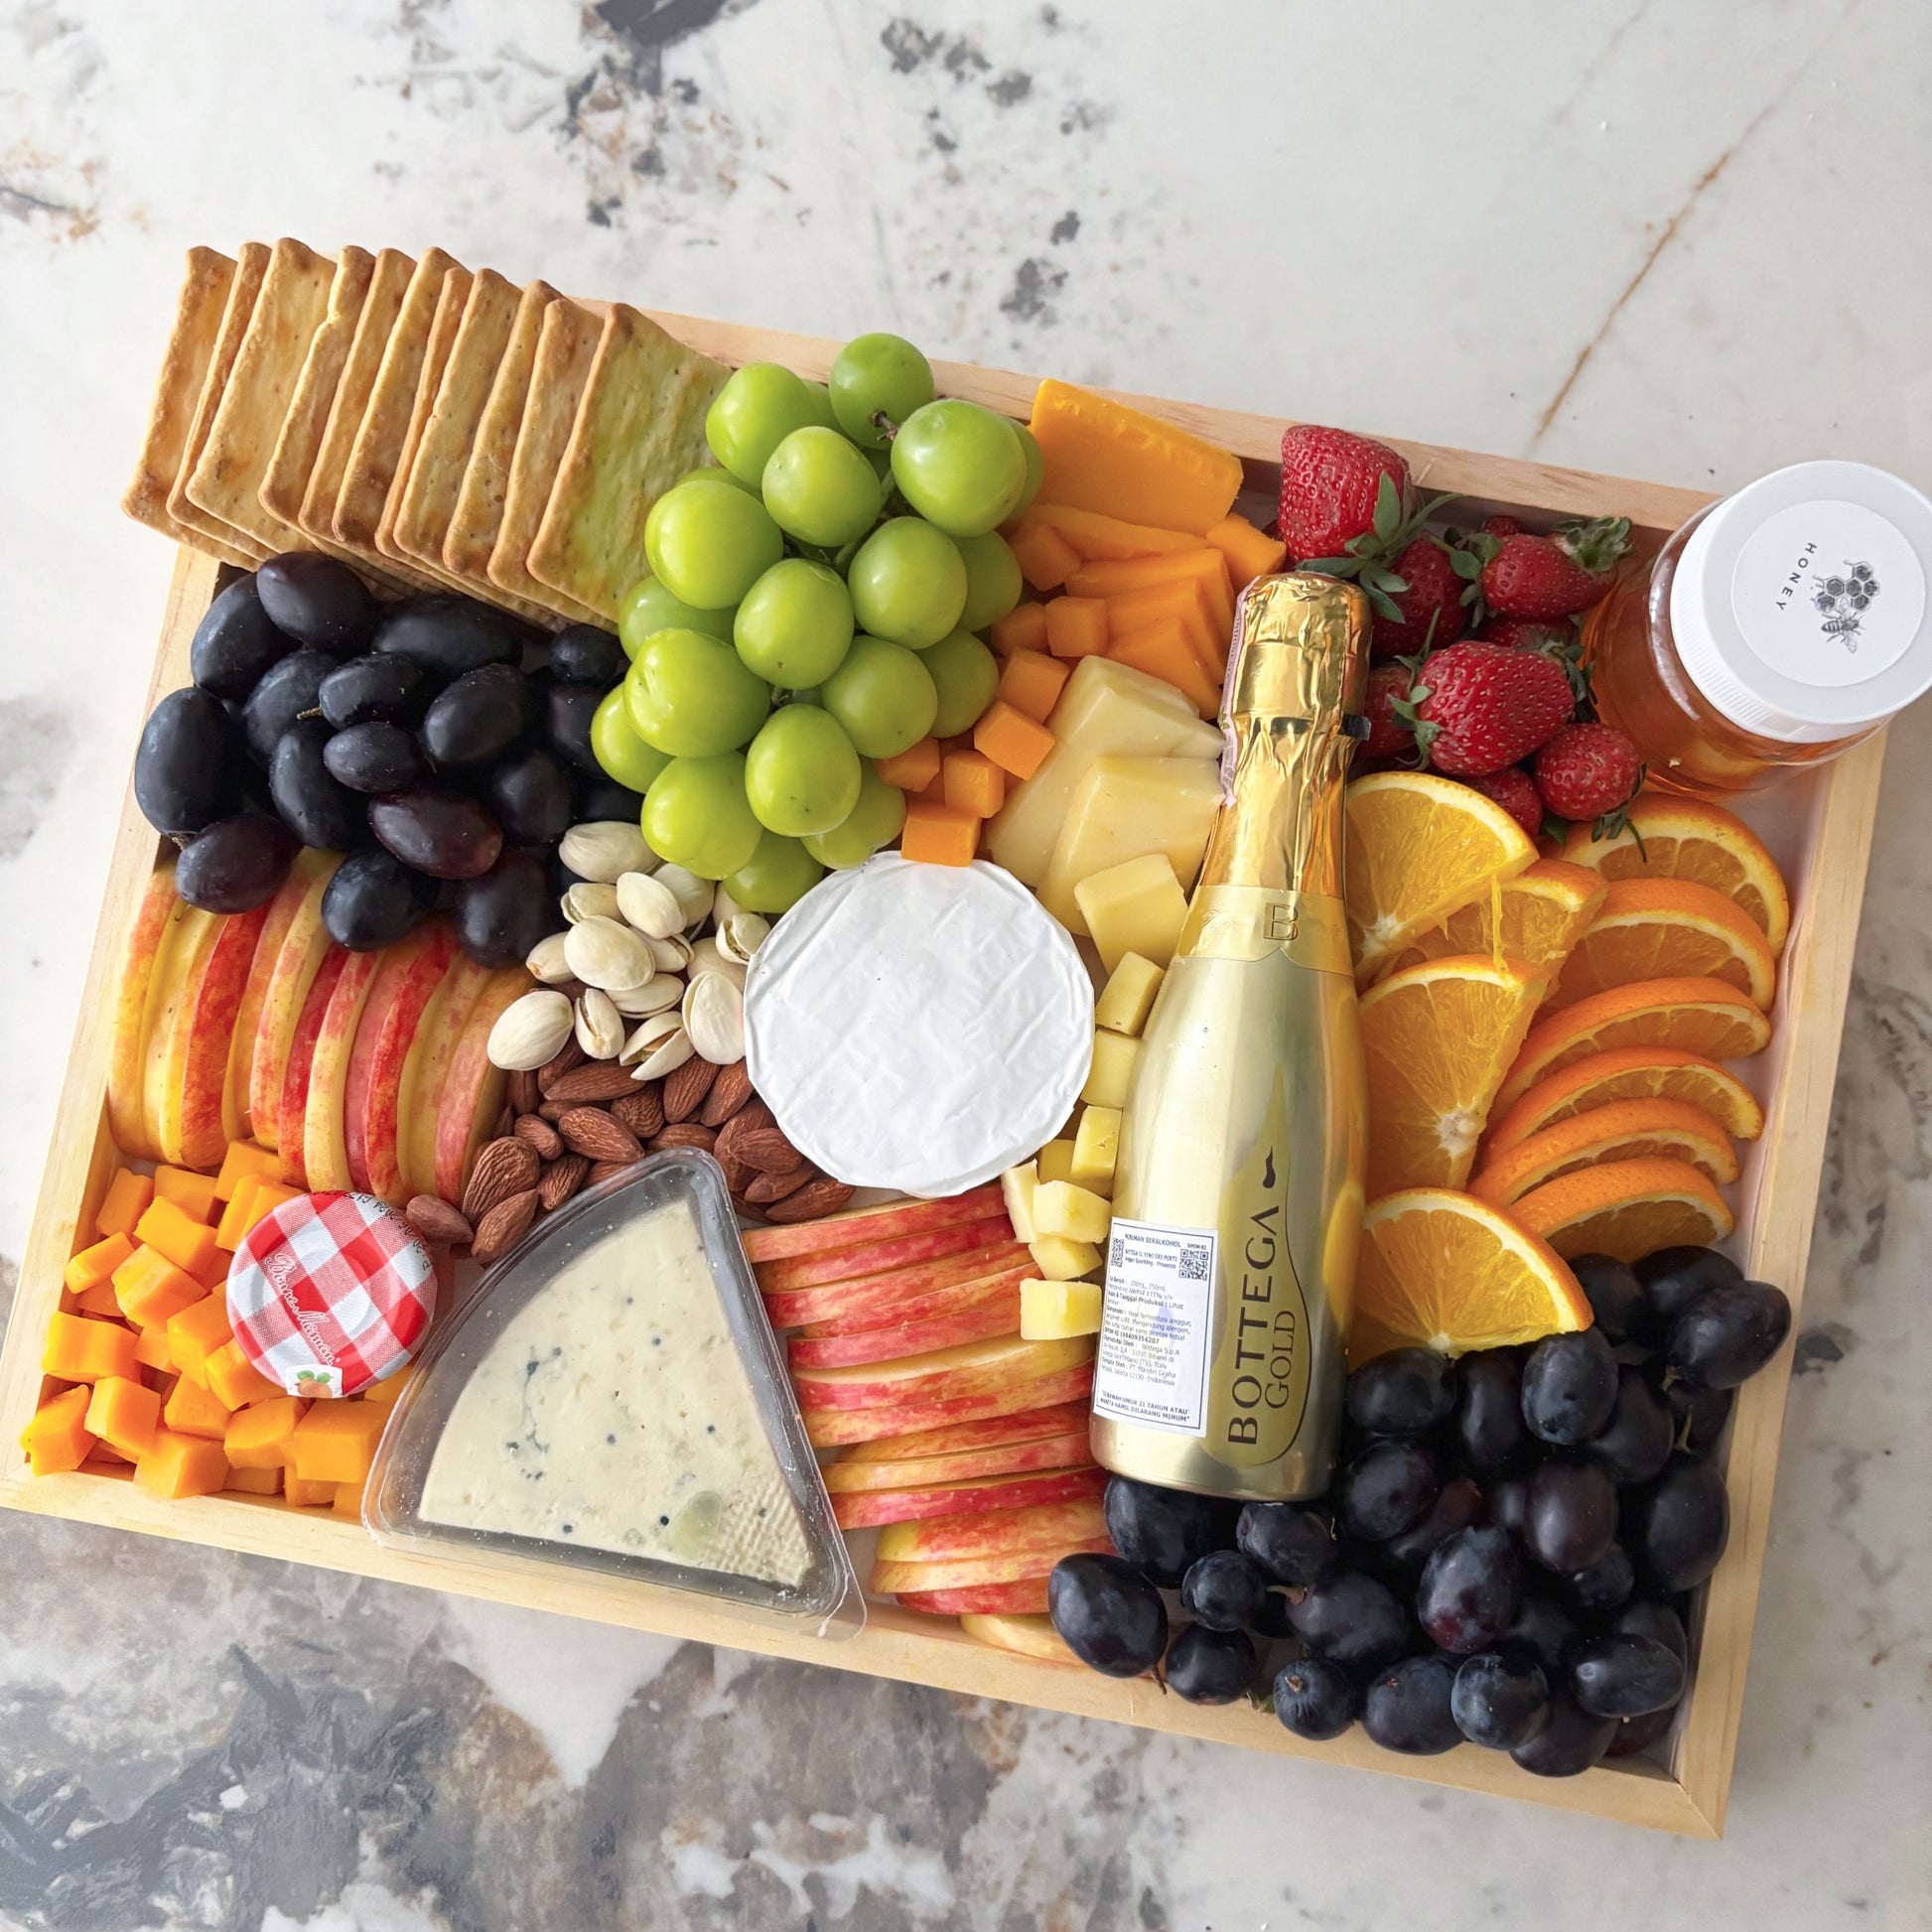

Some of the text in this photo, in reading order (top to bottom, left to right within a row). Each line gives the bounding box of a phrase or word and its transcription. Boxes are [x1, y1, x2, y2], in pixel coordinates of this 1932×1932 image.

[1776, 542, 1817, 611] HONEY
[1263, 902, 1299, 941] B
[265, 1253, 334, 1366] Bonne Maman
[1138, 1297, 1164, 1307] Produksi
[1227, 1205, 1280, 1446] BOTTEGA
[1264, 1310, 1296, 1409] GOLD
[1130, 1407, 1162, 1418] DILARANG
[1147, 1403, 1170, 1412] TAHUN
